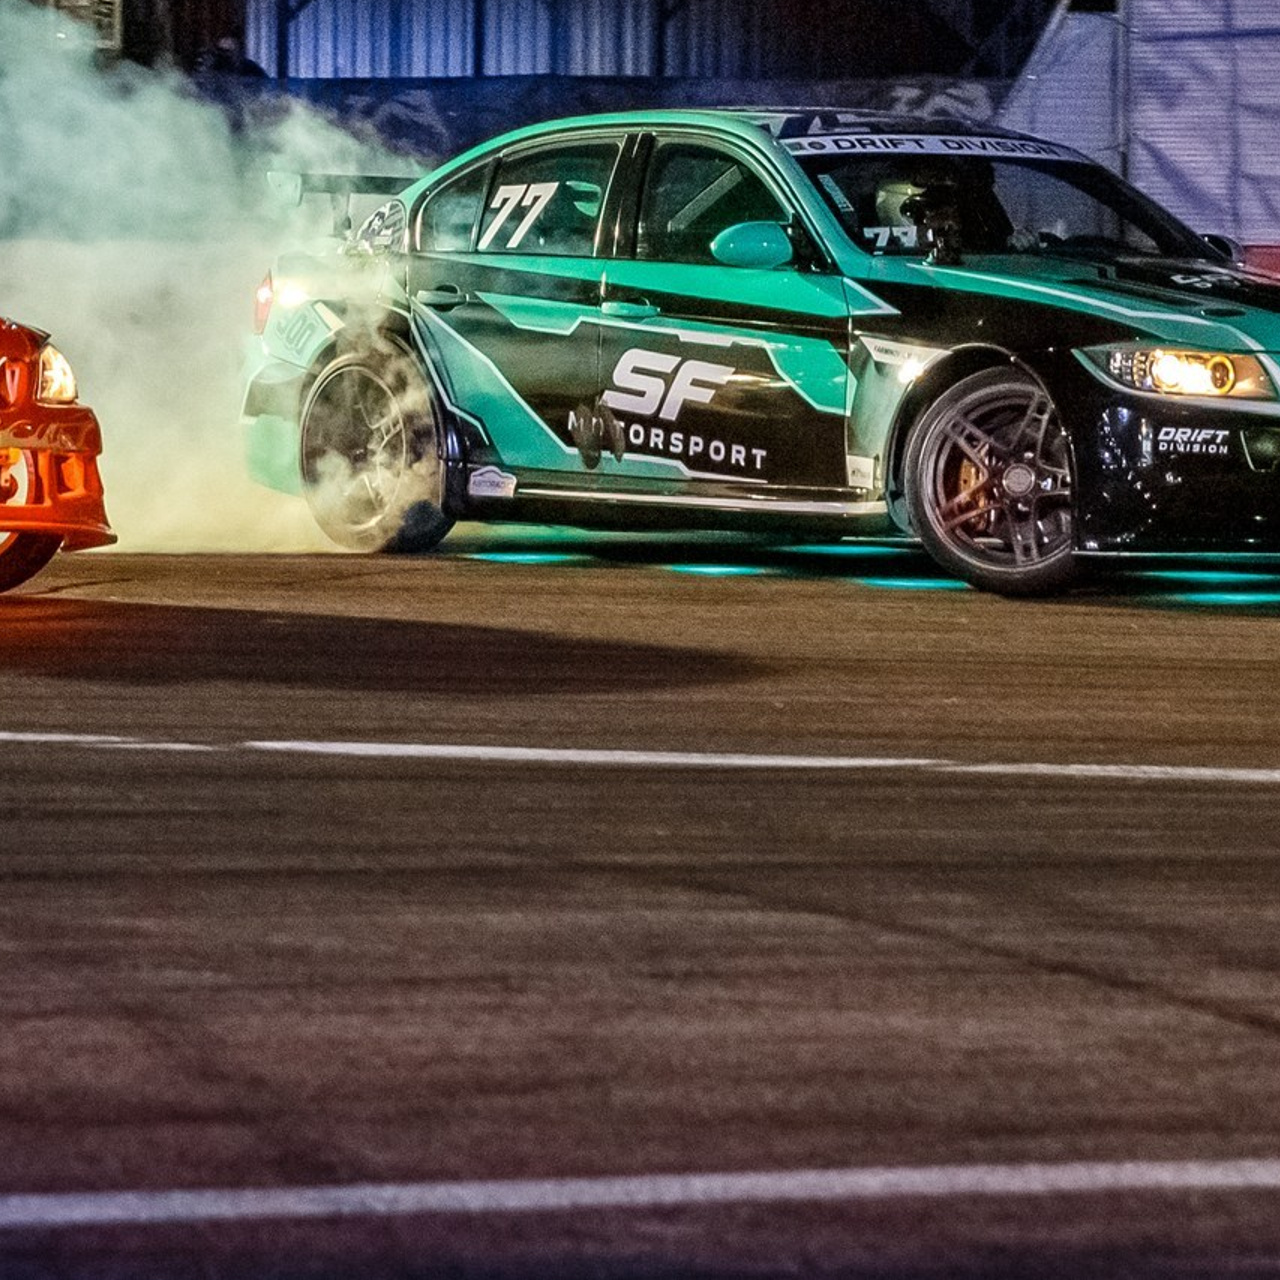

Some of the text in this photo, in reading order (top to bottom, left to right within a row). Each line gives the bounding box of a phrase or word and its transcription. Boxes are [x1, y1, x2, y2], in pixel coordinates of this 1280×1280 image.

[831, 137, 1062, 158] DRIFT DIVISION
[477, 182, 559, 250] 77
[601, 348, 736, 421] SF
[568, 410, 768, 470] MOORSPORT
[1158, 426, 1230, 443] DRIFT
[1158, 441, 1228, 454] DIVISION
